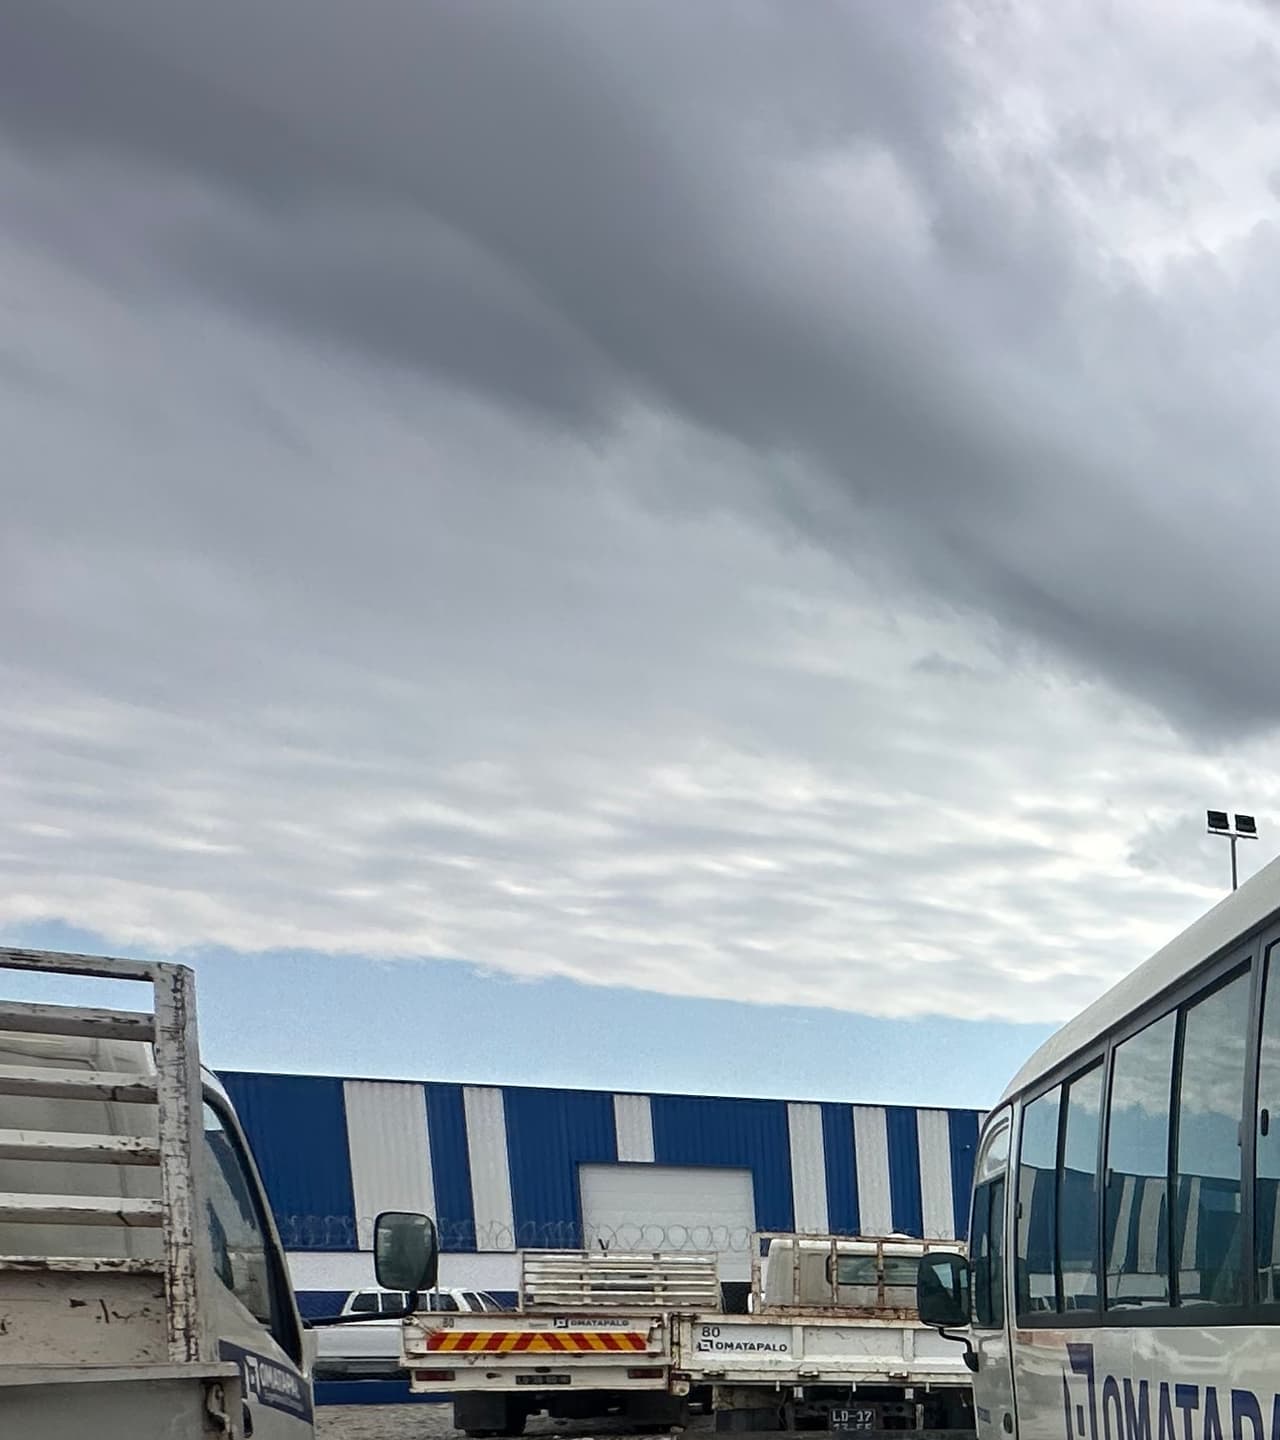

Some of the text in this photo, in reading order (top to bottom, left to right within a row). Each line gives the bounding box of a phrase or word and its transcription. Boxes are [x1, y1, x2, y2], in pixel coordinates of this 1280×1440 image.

[570, 1319, 630, 1327] OMATAPALO
[702, 1326, 720, 1338] 80
[715, 1341, 788, 1352] OMATAPALO
